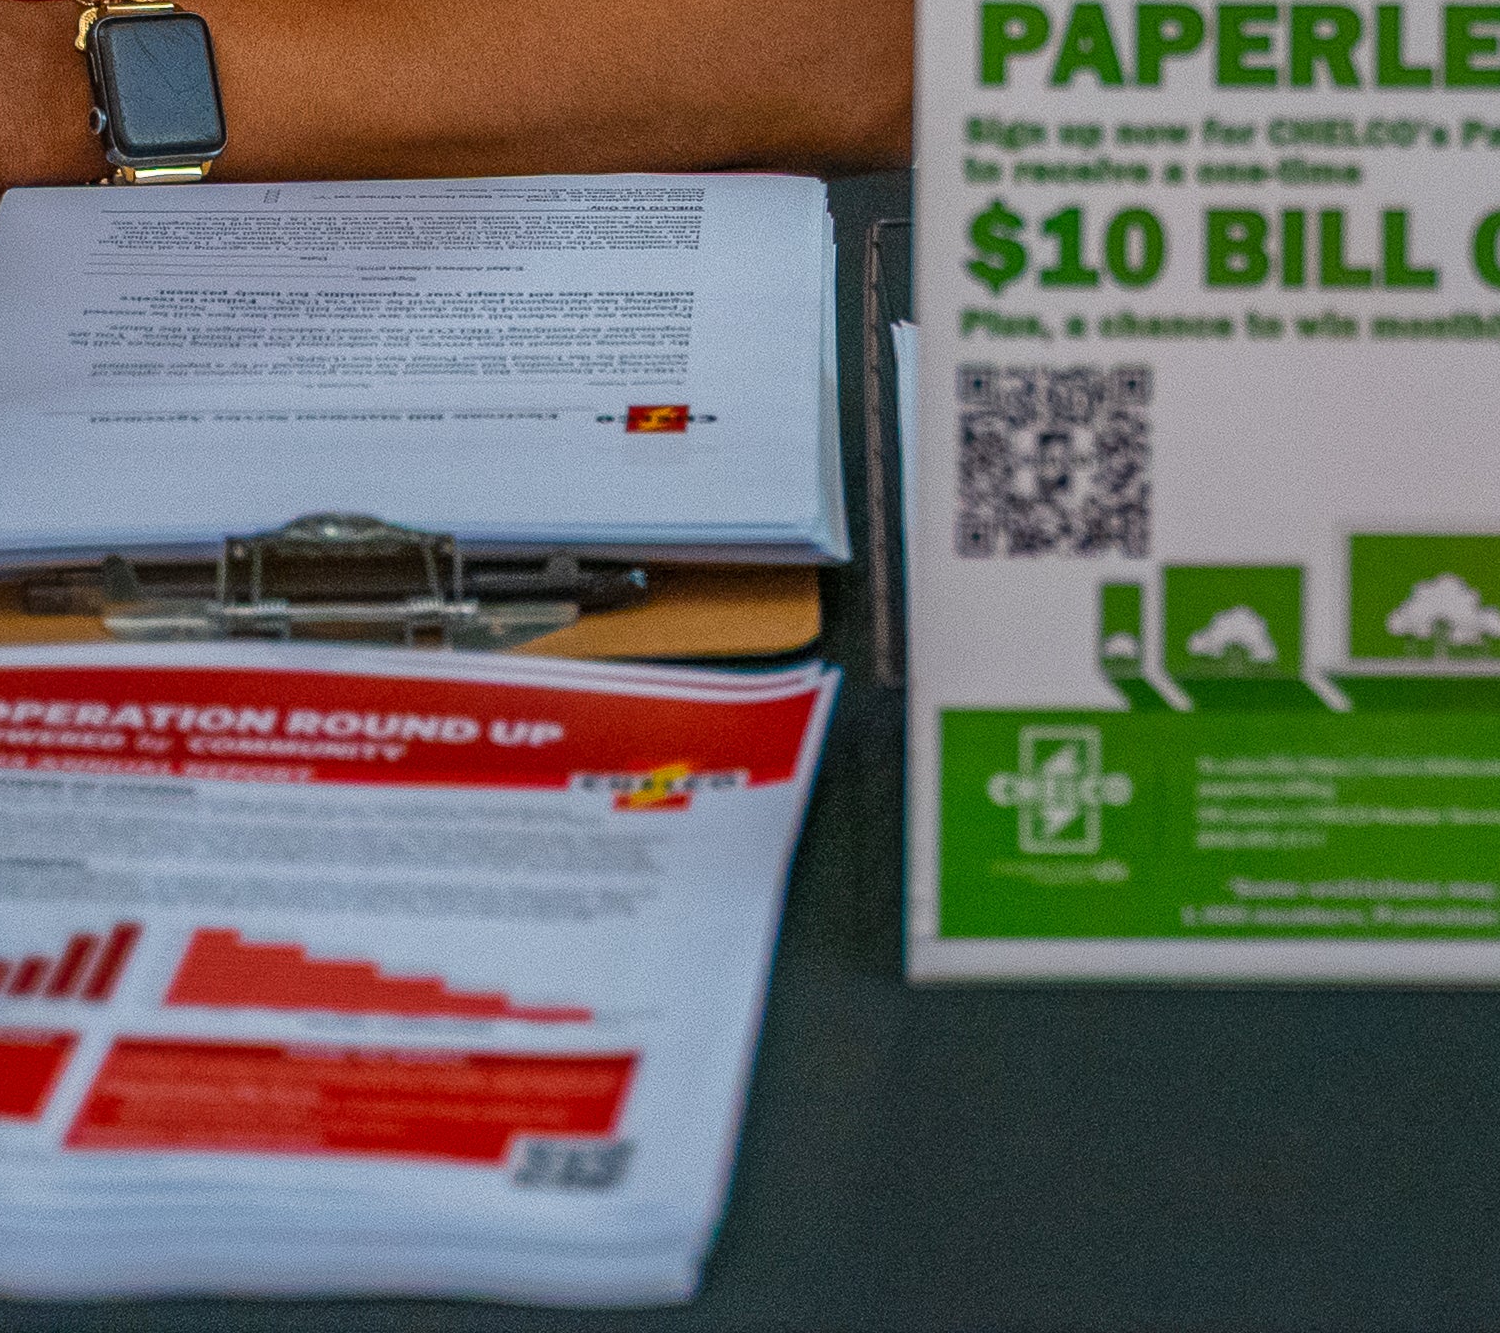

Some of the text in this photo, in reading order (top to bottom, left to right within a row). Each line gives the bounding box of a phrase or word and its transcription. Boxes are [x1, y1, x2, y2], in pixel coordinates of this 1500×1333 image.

[965, 116, 1046, 150] Sign
[1059, 124, 1101, 150] up
[1115, 125, 1188, 145] now
[1204, 117, 1255, 145] for
[1267, 117, 1448, 147] CHELCO's
[964, 158, 1361, 185] to receive a one-time
[966, 198, 1167, 296] $10
[1206, 207, 1438, 288] BILL
[960, 309, 1052, 341] Plus,
[1067, 316, 1085, 339] a
[1100, 312, 1232, 339] chance
[1248, 313, 1281, 339] to
[1296, 312, 1357, 339] win
[286, 708, 478, 744] ROUND
[489, 719, 564, 746] UP
[187, 734, 406, 761] COMMUNITY
